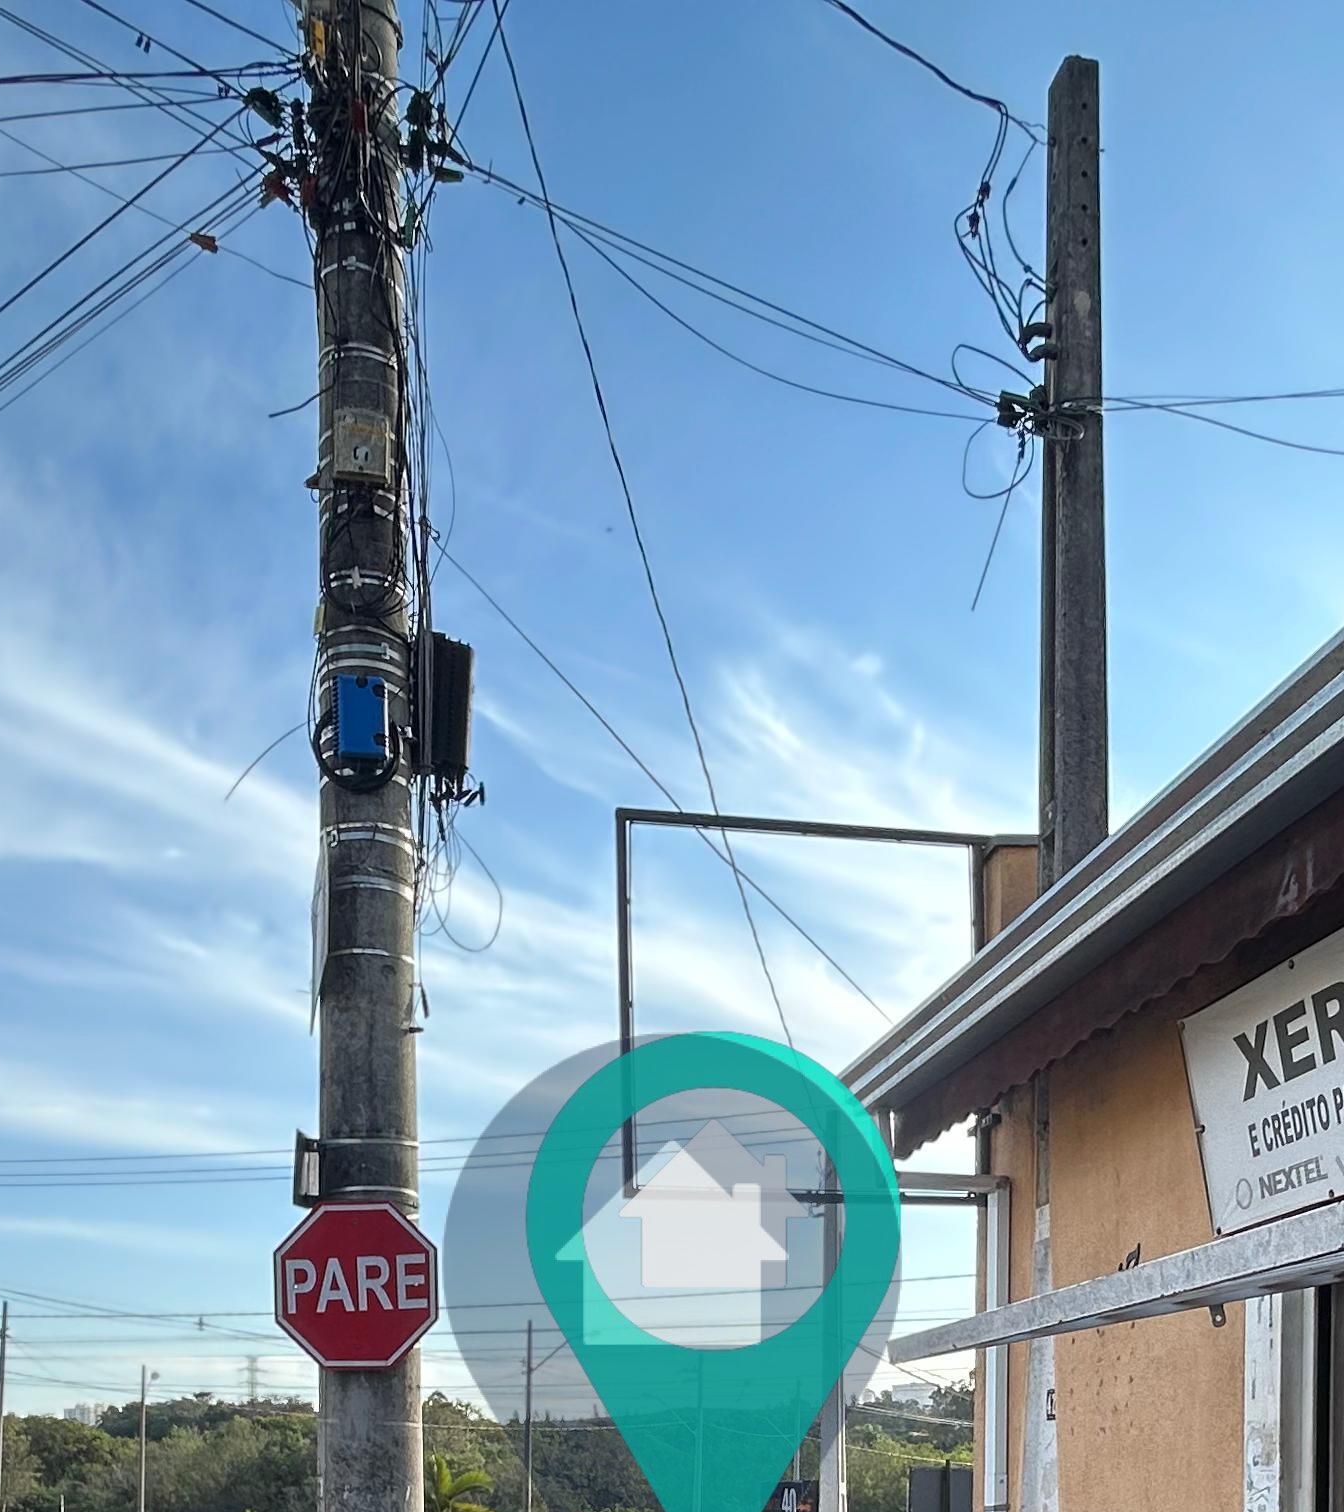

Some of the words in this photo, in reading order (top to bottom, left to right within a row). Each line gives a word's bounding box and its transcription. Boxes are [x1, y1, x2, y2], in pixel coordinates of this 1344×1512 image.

[1248, 1122, 1260, 1158] E
[1261, 1093, 1331, 1152] CRÉDITO
[1258, 1156, 1329, 1200] NEXTEL
[285, 1253, 429, 1315] PARE
